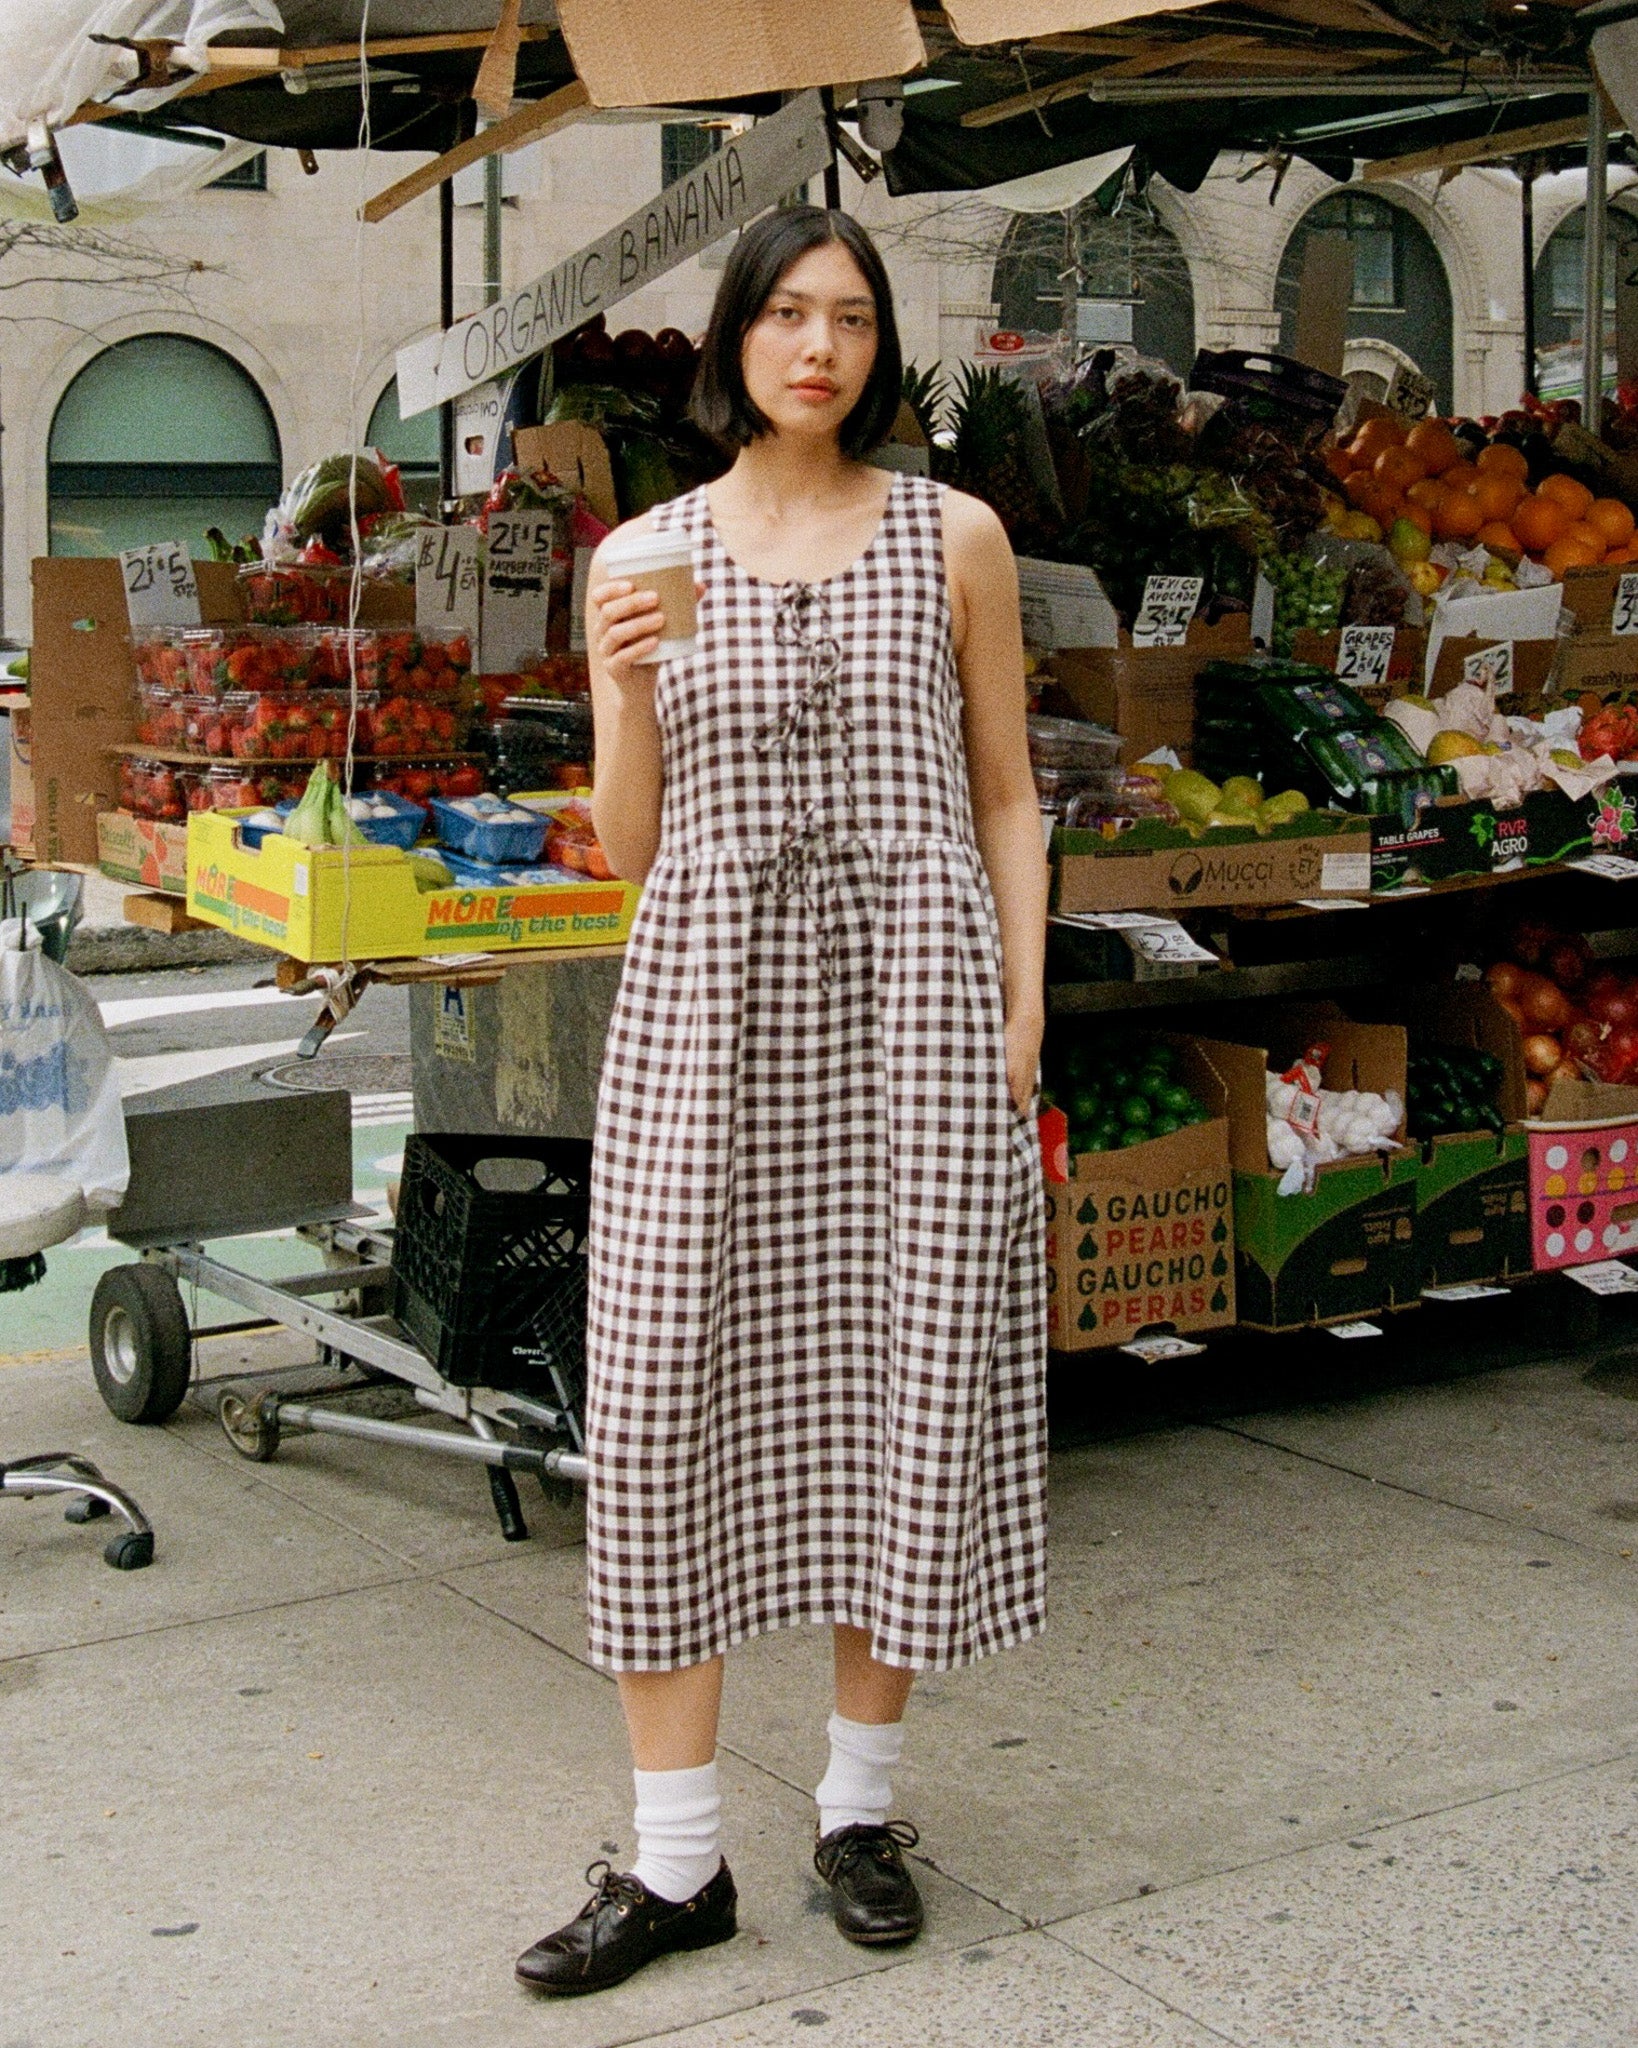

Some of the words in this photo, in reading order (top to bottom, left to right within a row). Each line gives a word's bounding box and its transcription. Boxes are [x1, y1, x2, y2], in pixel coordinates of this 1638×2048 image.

[463, 253, 602, 381] ORGANIC
[619, 146, 747, 287] BANANA
[1146, 576, 1199, 590] MEXICO
[1146, 591, 1198, 602] AVOCADO
[1344, 630, 1393, 649] GRAPES
[1378, 834, 1405, 847] TABLE
[1406, 828, 1440, 842] GRAPES
[1495, 818, 1529, 837] RVR
[1490, 836, 1528, 857] AGRO
[195, 864, 236, 902] MORE
[427, 893, 516, 925] MORE
[497, 918, 523, 942] of
[528, 914, 566, 933] the
[572, 909, 620, 931] best
[1106, 1181, 1229, 1223] GAUCHO
[1105, 1218, 1206, 1257] PEARS
[1076, 1253, 1206, 1296] GAUCHO
[1102, 1287, 1207, 1328] PERAS
